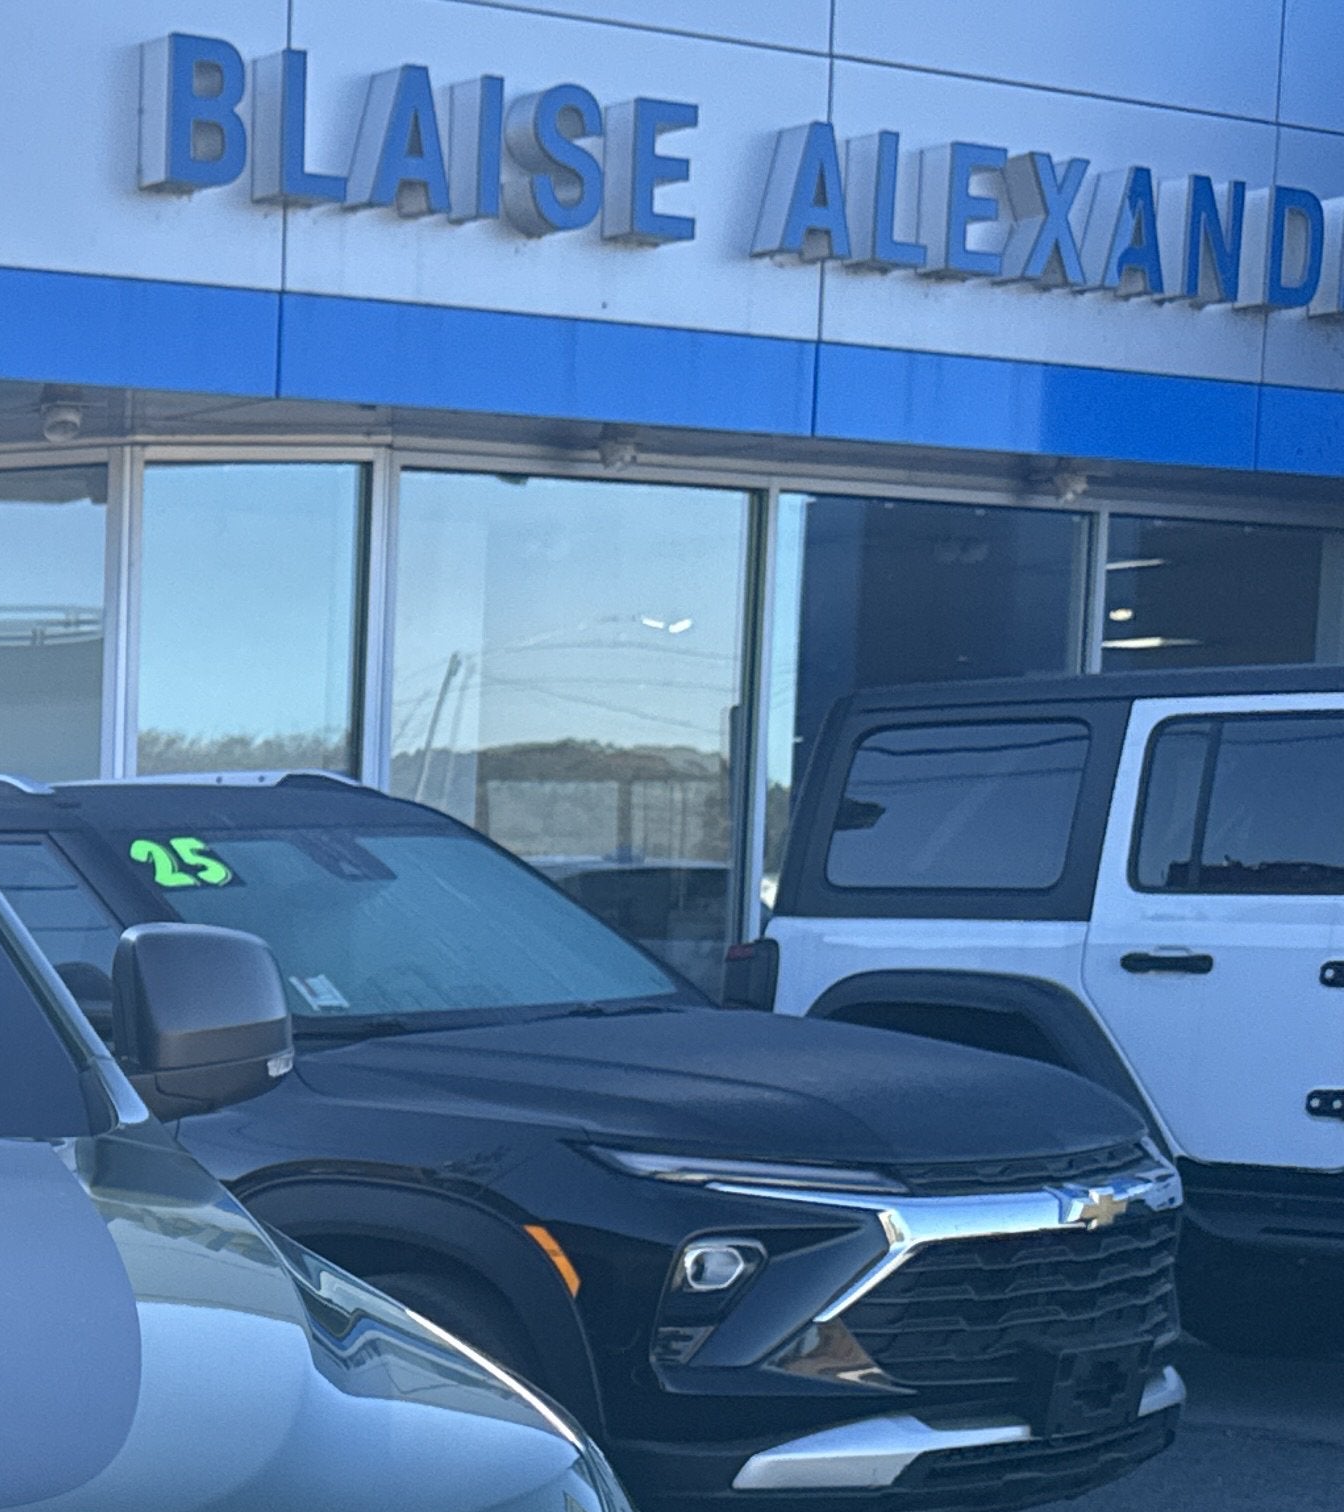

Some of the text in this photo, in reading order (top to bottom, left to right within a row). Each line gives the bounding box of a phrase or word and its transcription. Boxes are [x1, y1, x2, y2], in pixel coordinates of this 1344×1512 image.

[142, 32, 1344, 312] BLAISE ALEXAND
[129, 836, 232, 888] 25
